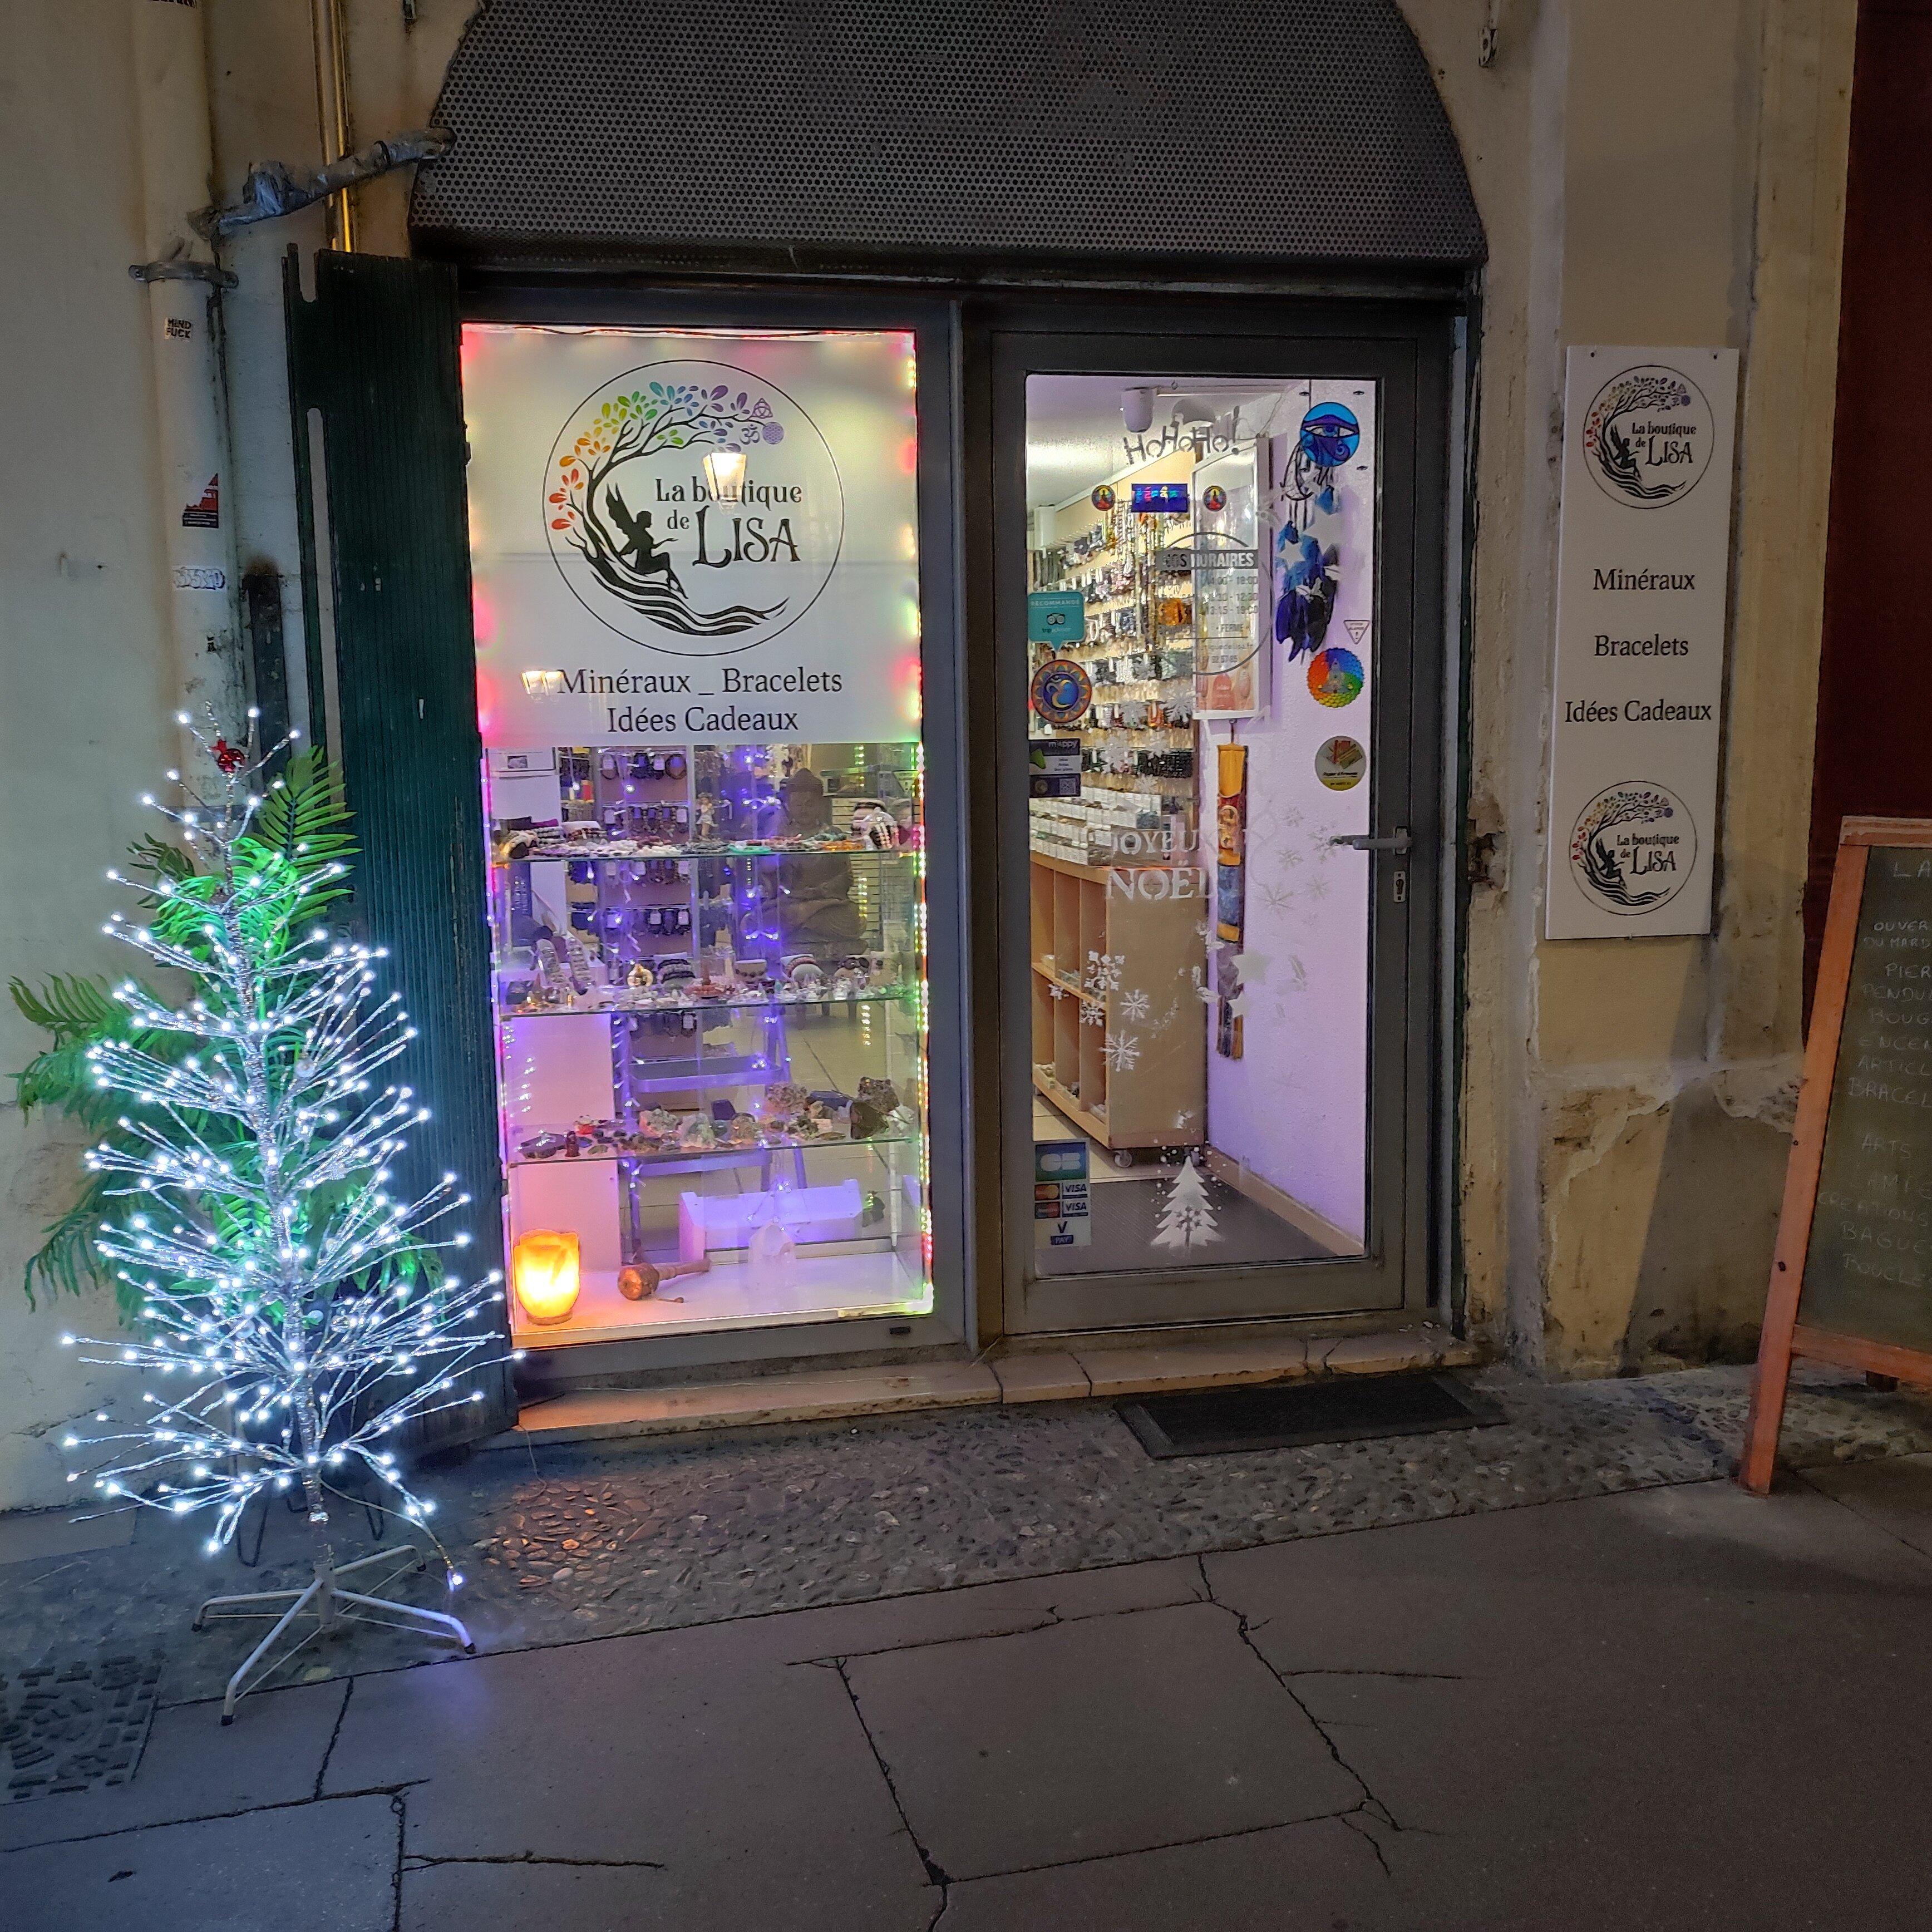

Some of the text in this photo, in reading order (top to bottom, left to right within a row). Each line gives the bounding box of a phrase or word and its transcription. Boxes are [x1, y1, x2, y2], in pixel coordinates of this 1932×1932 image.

[166, 327, 191, 338] FUCK
[1632, 421, 1697, 438] La boutique
[1635, 435, 1693, 466] de LISA
[655, 479, 686, 502] La
[667, 505, 801, 568] de LISA
[1593, 568, 1695, 590] Minéraux
[1594, 633, 1689, 656] Bracelets
[557, 669, 691, 694] Minéraux
[722, 667, 842, 693] Bracelets
[607, 705, 799, 732] Idées Cadeaux
[1565, 698, 1712, 722] Idées Cadeaux
[1617, 833, 1679, 848] La boutique
[1620, 846, 1677, 875] de LISA
[1862, 936, 1884, 947] DU
[1885, 962, 1932, 979] PIER
[1066, 1184, 1087, 1192] VISA
[1066, 1202, 1087, 1211] VISA
